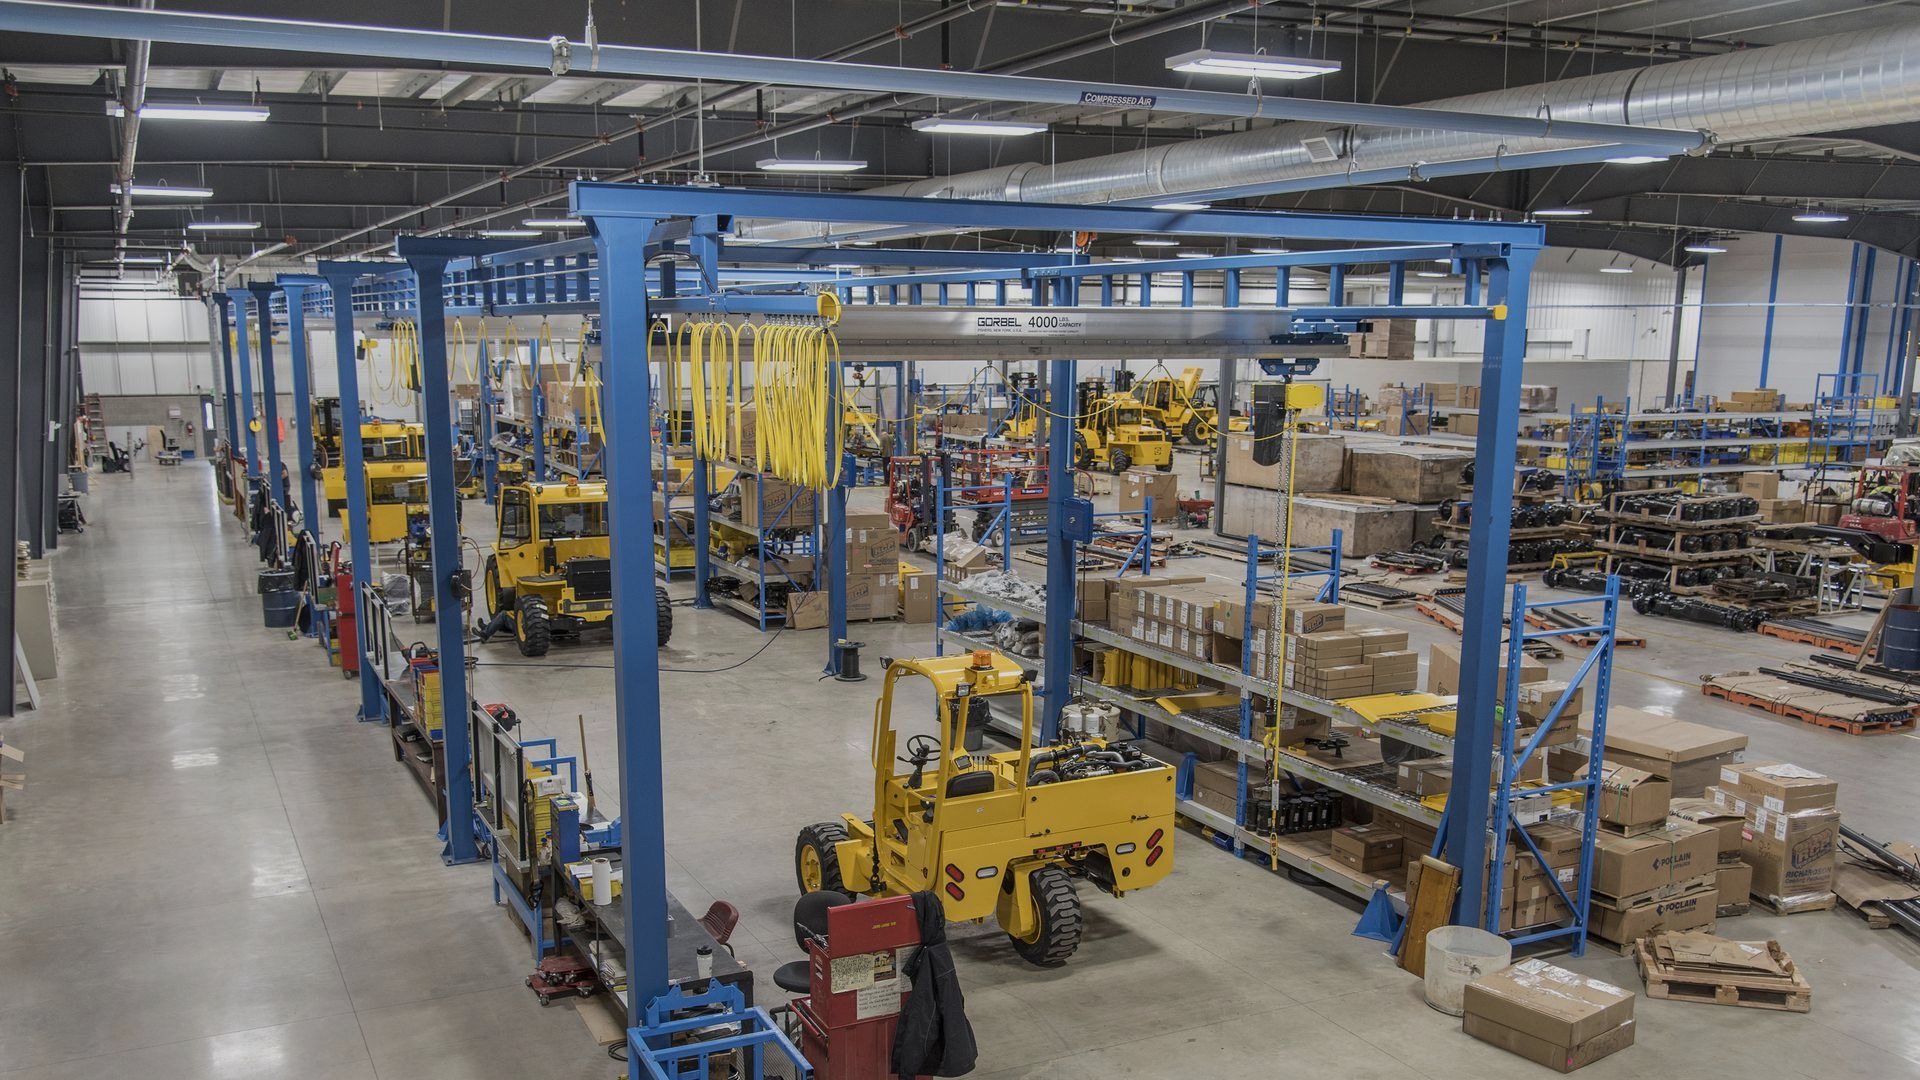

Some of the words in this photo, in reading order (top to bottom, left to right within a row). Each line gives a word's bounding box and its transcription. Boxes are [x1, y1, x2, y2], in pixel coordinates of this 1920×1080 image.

[1085, 93, 1137, 104] COMPRESSED
[977, 317, 1022, 327] GORBEL
[1028, 316, 1058, 328] 4000
